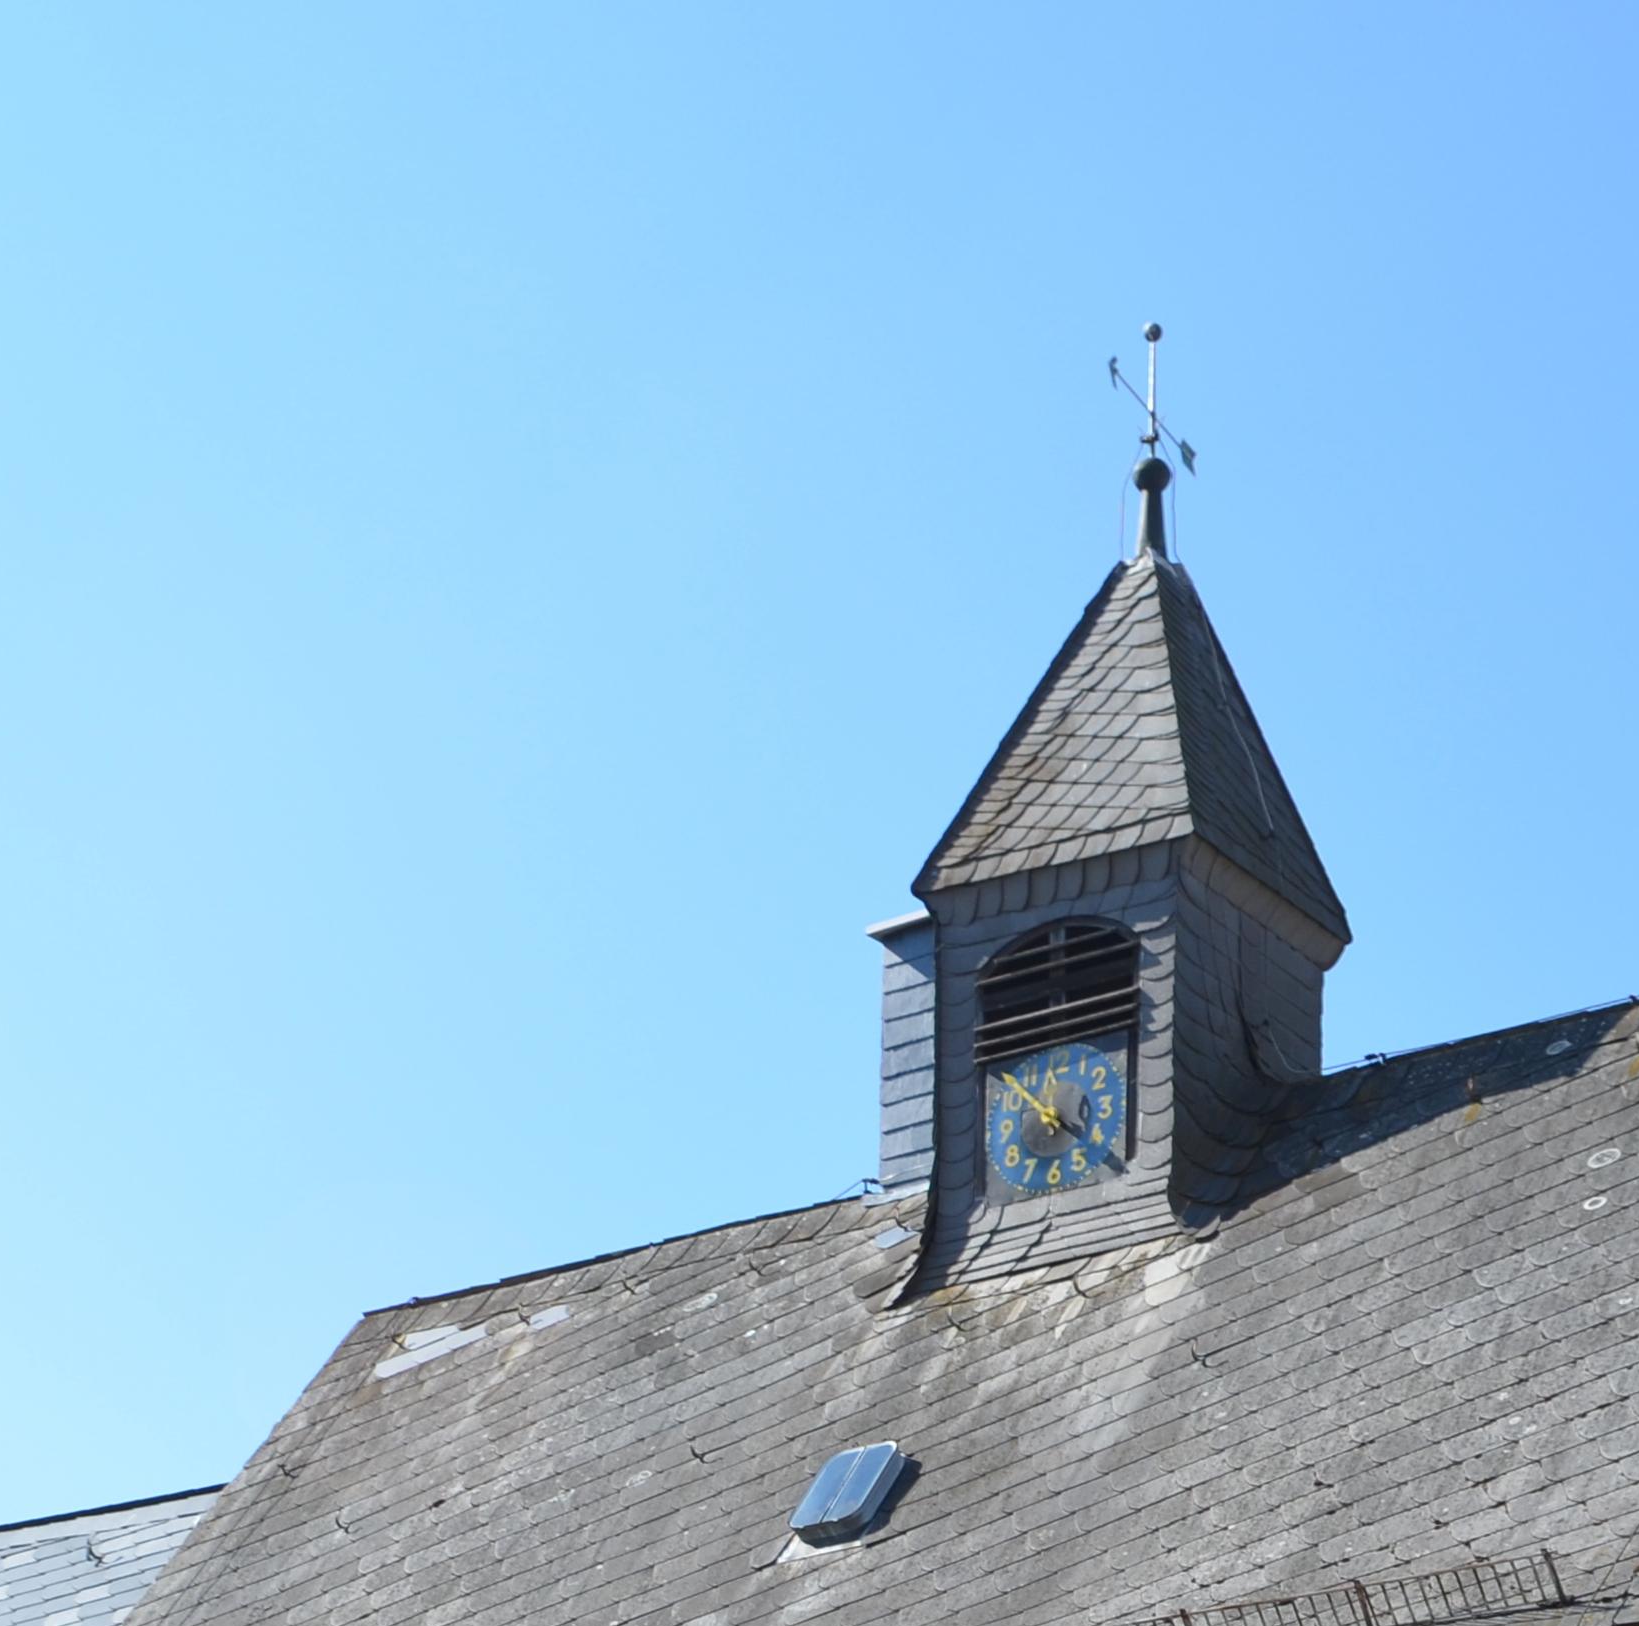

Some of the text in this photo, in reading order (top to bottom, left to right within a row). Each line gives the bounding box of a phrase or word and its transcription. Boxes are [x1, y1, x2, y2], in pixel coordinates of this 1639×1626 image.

[1022, 1064, 1038, 1087] 11
[1079, 1055, 1087, 1076] 1
[1091, 1066, 1107, 1090] 2
[1002, 1090, 1023, 1112] 10
[1097, 1094, 1113, 1119] 3
[1000, 1118, 1014, 1143] 9
[1090, 1122, 1105, 1145] 4
[1004, 1143, 1020, 1168] 8
[1071, 1147, 1087, 1172] 5
[1022, 1157, 1038, 1184] 7
[1046, 1159, 1062, 1184] 6
